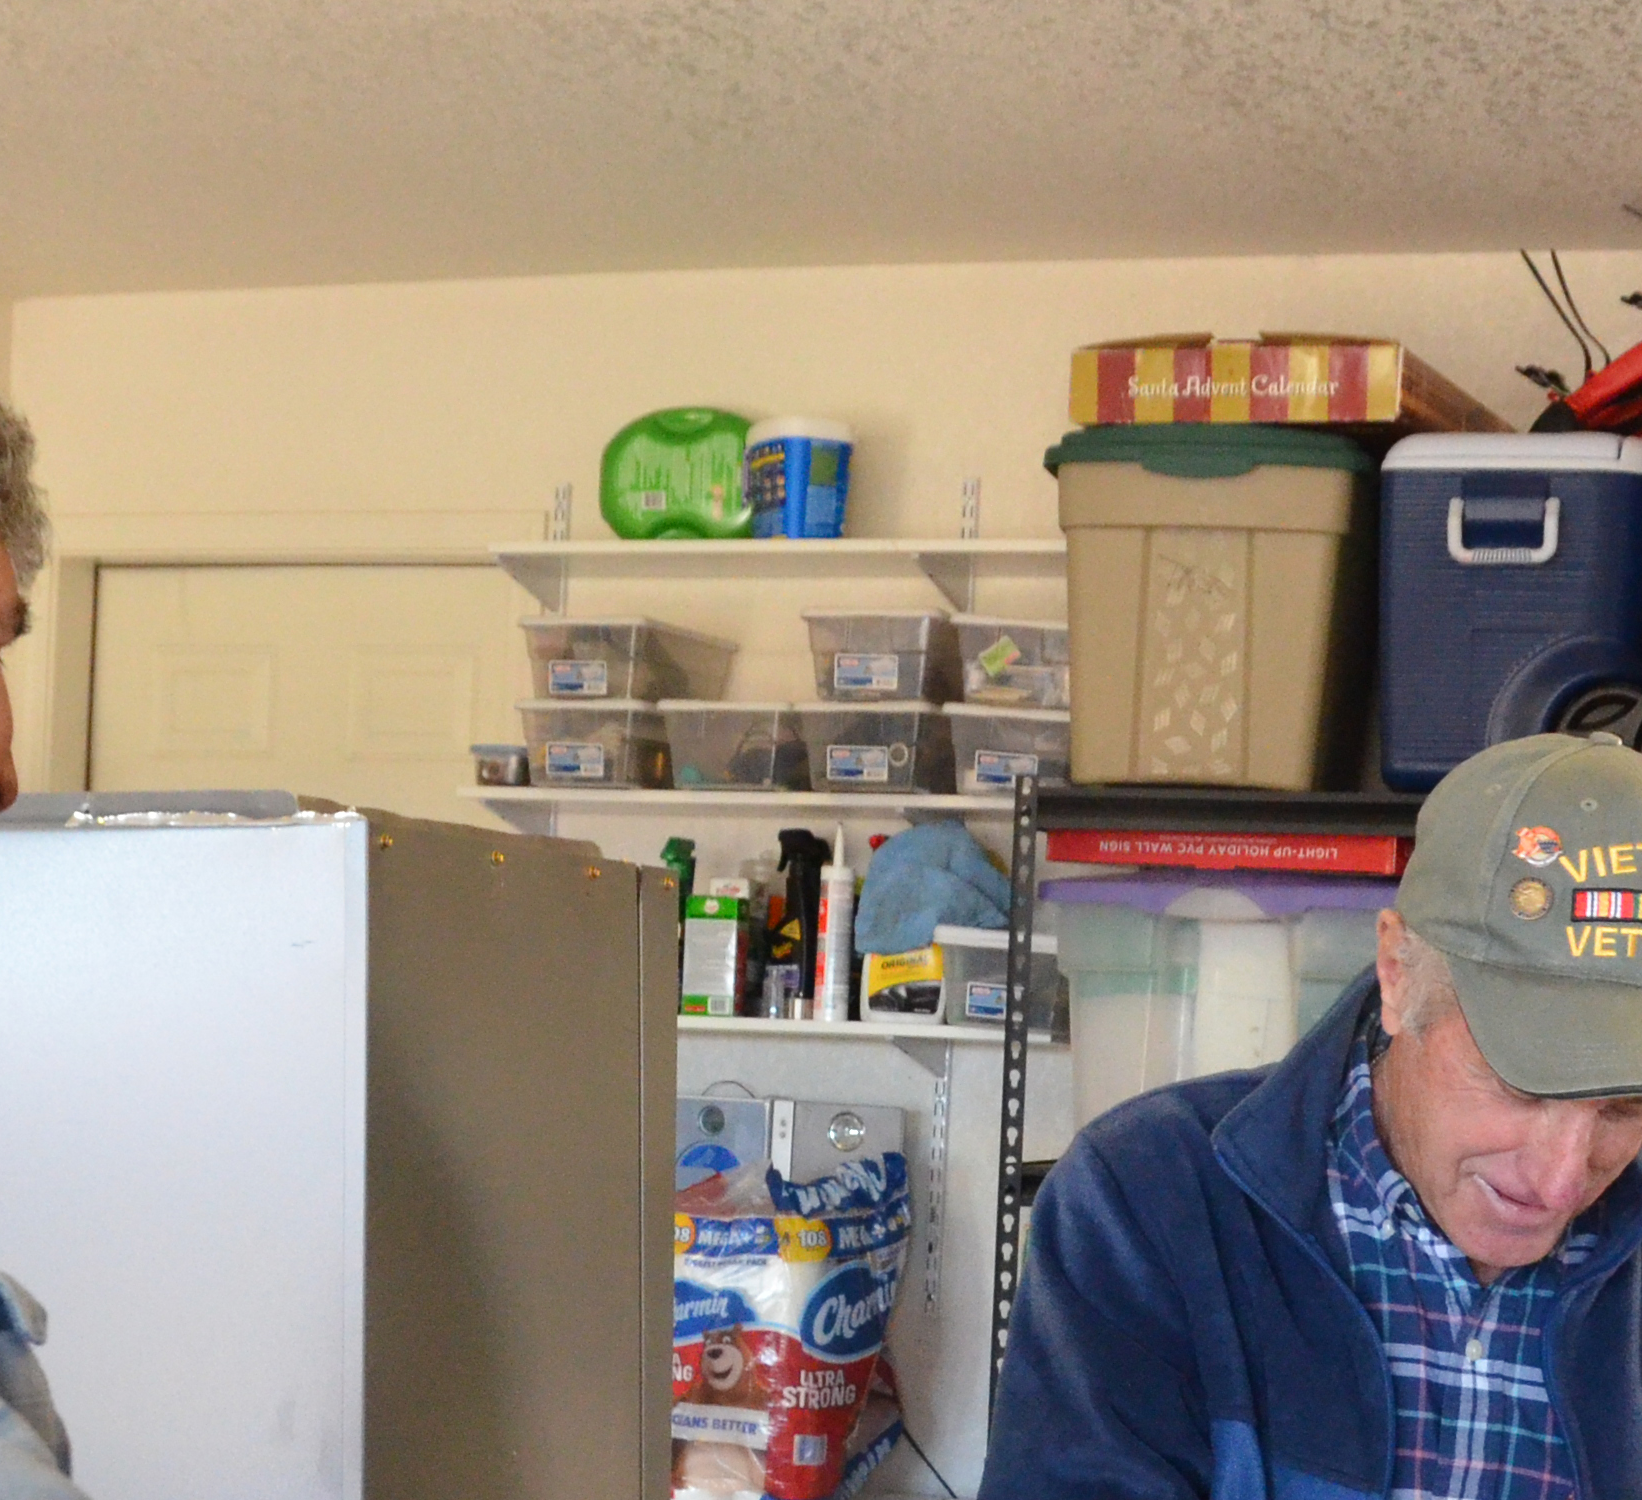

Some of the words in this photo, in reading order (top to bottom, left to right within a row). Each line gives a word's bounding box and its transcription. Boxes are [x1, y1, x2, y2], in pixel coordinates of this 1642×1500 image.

[1128, 375, 1178, 397] Santa
[1182, 374, 1247, 397] Advent
[1251, 372, 1339, 396] Calendar
[1099, 840, 1131, 853] SIGN
[1135, 840, 1173, 854] WALL
[1177, 842, 1204, 855] PVC
[1208, 844, 1270, 857] HOLIDAY
[1274, 846, 1338, 859] LIGHT-UP
[798, 1228, 828, 1248] 108
[674, 1292, 729, 1321] armin
[782, 1384, 857, 1411] STRONG
[712, 1417, 757, 1435] BETTER
